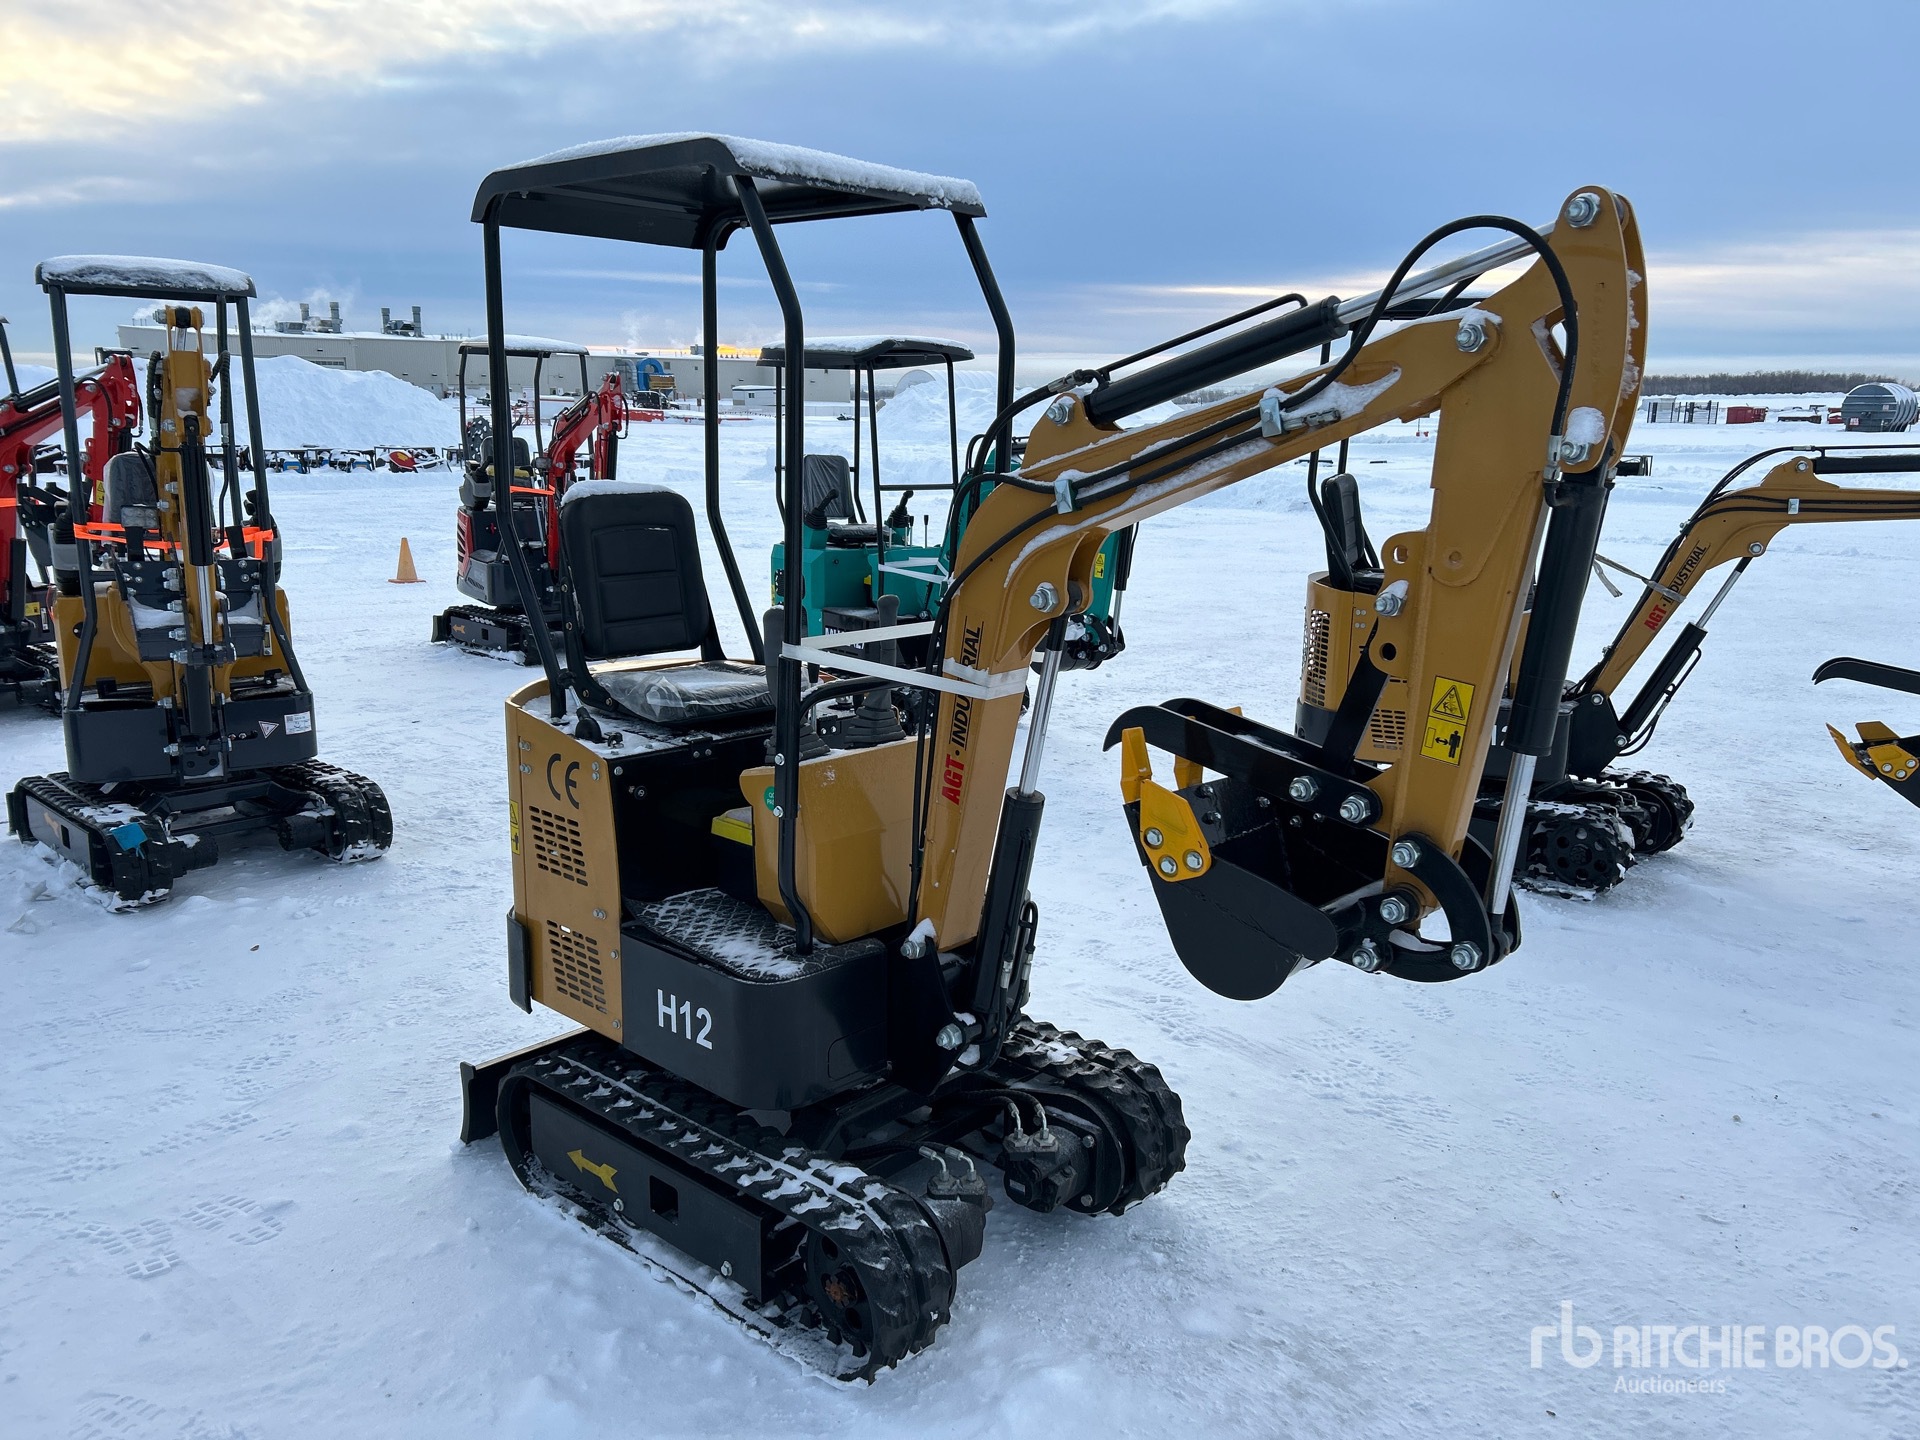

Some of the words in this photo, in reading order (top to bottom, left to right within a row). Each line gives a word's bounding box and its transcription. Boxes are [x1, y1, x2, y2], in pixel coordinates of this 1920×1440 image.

[1644, 604, 1667, 631] AGT
[1663, 546, 1707, 604] IDUSTRIAL
[951, 627, 981, 748] INDURIAL
[941, 753, 965, 806] AGT
[657, 989, 713, 1050] H12
